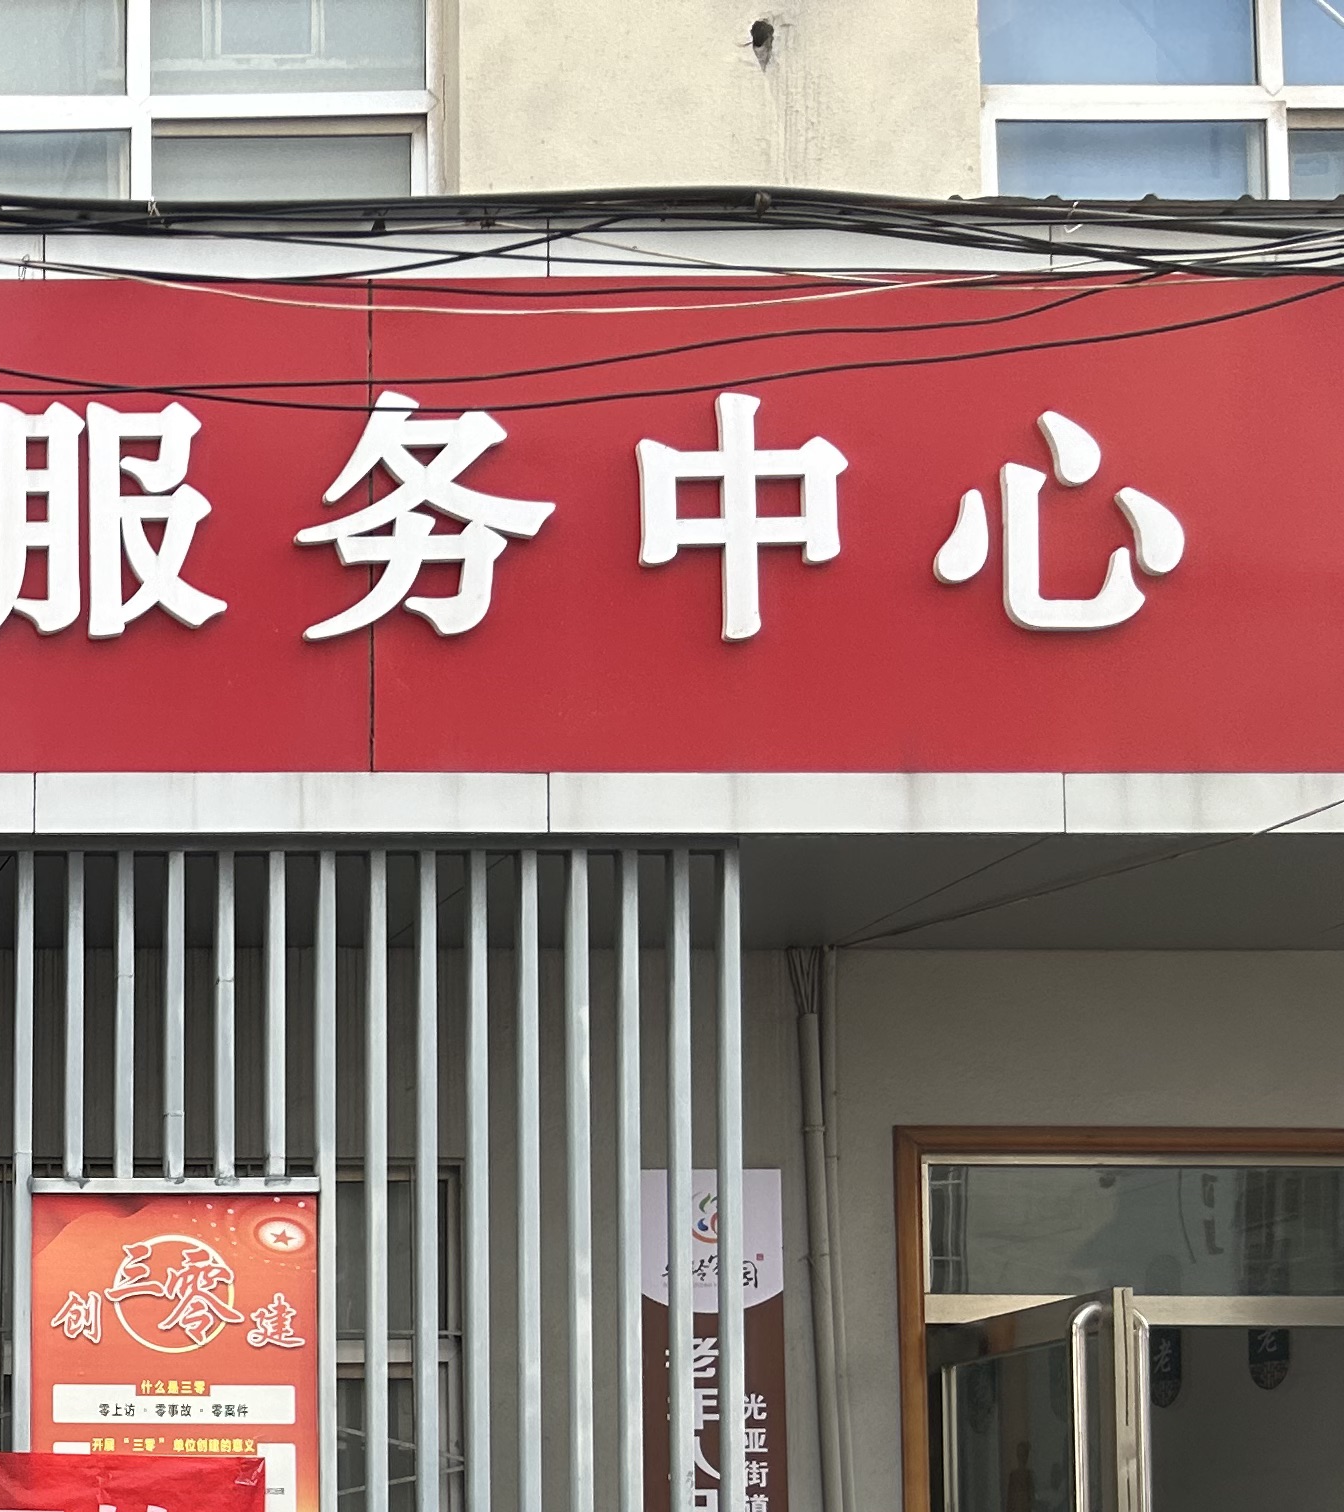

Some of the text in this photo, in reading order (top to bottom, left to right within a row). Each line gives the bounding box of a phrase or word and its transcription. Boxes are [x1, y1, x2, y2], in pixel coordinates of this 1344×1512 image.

[140, 1379, 207, 1394] 什么是三零
